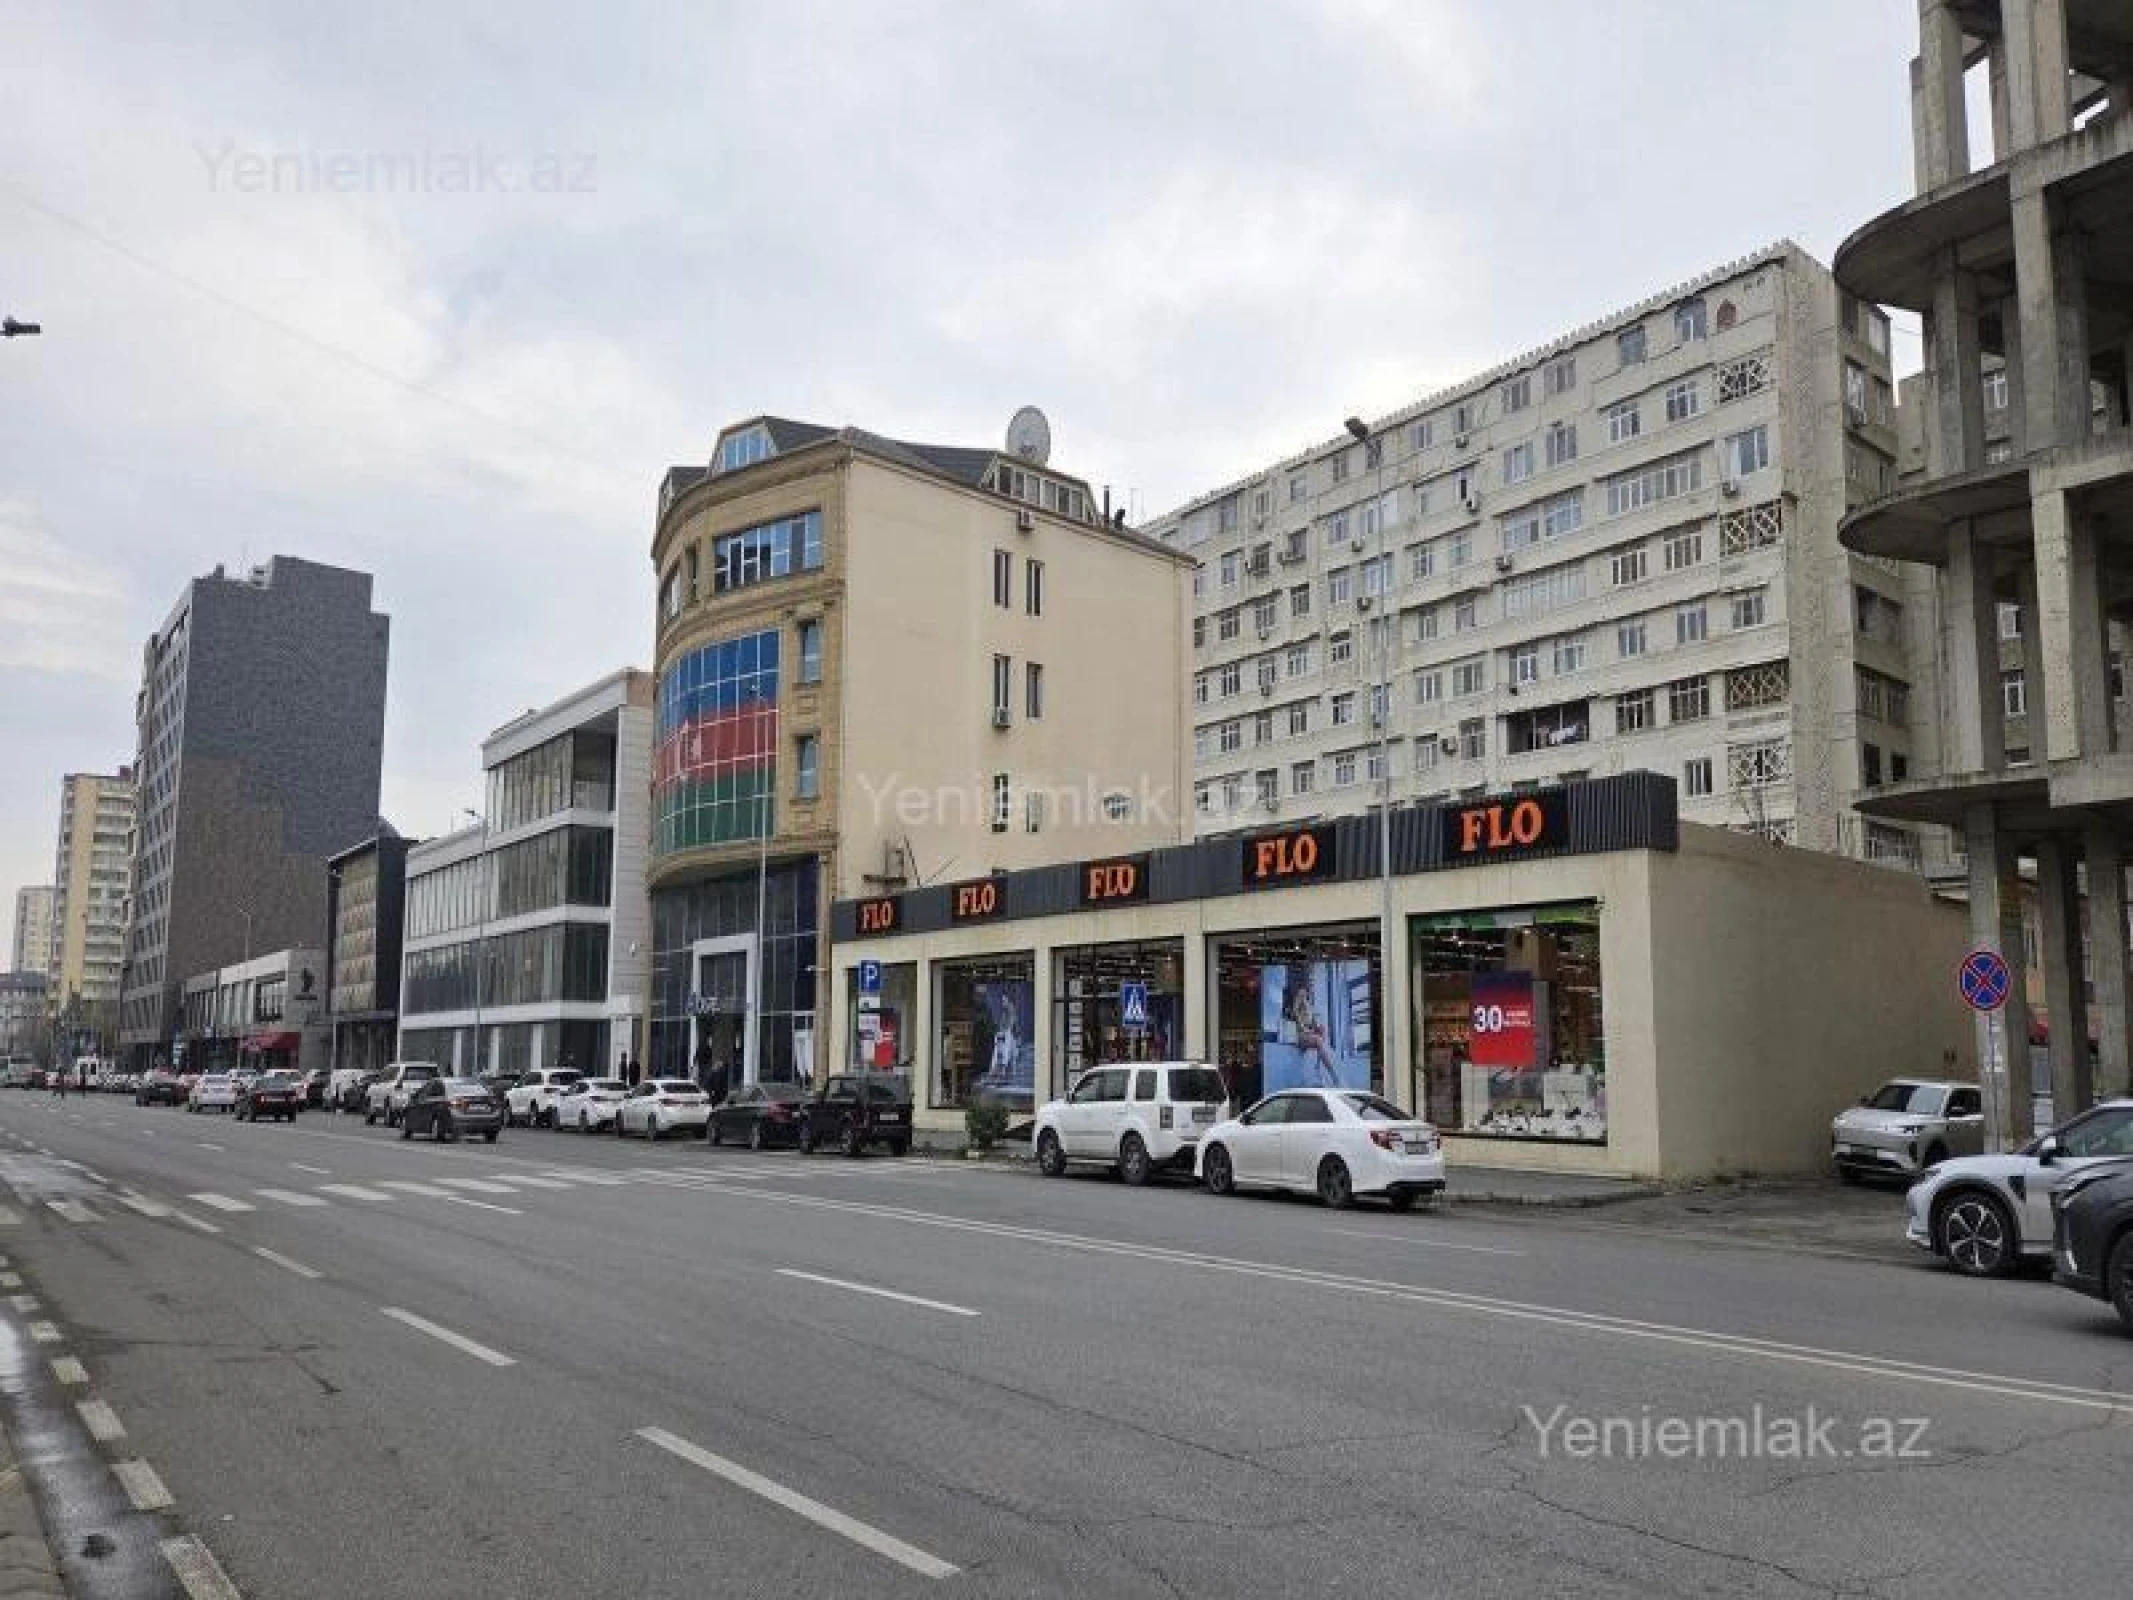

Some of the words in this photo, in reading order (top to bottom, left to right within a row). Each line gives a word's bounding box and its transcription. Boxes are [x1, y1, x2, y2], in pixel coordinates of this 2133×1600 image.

[1459, 799, 1543, 852] FLO
[1255, 833, 1318, 876] FLO
[958, 881, 997, 916] FLO
[1088, 862, 1137, 900] FLO
[862, 901, 894, 930] FLO
[864, 964, 878, 988] P
[1473, 1004, 1502, 1033] 30
